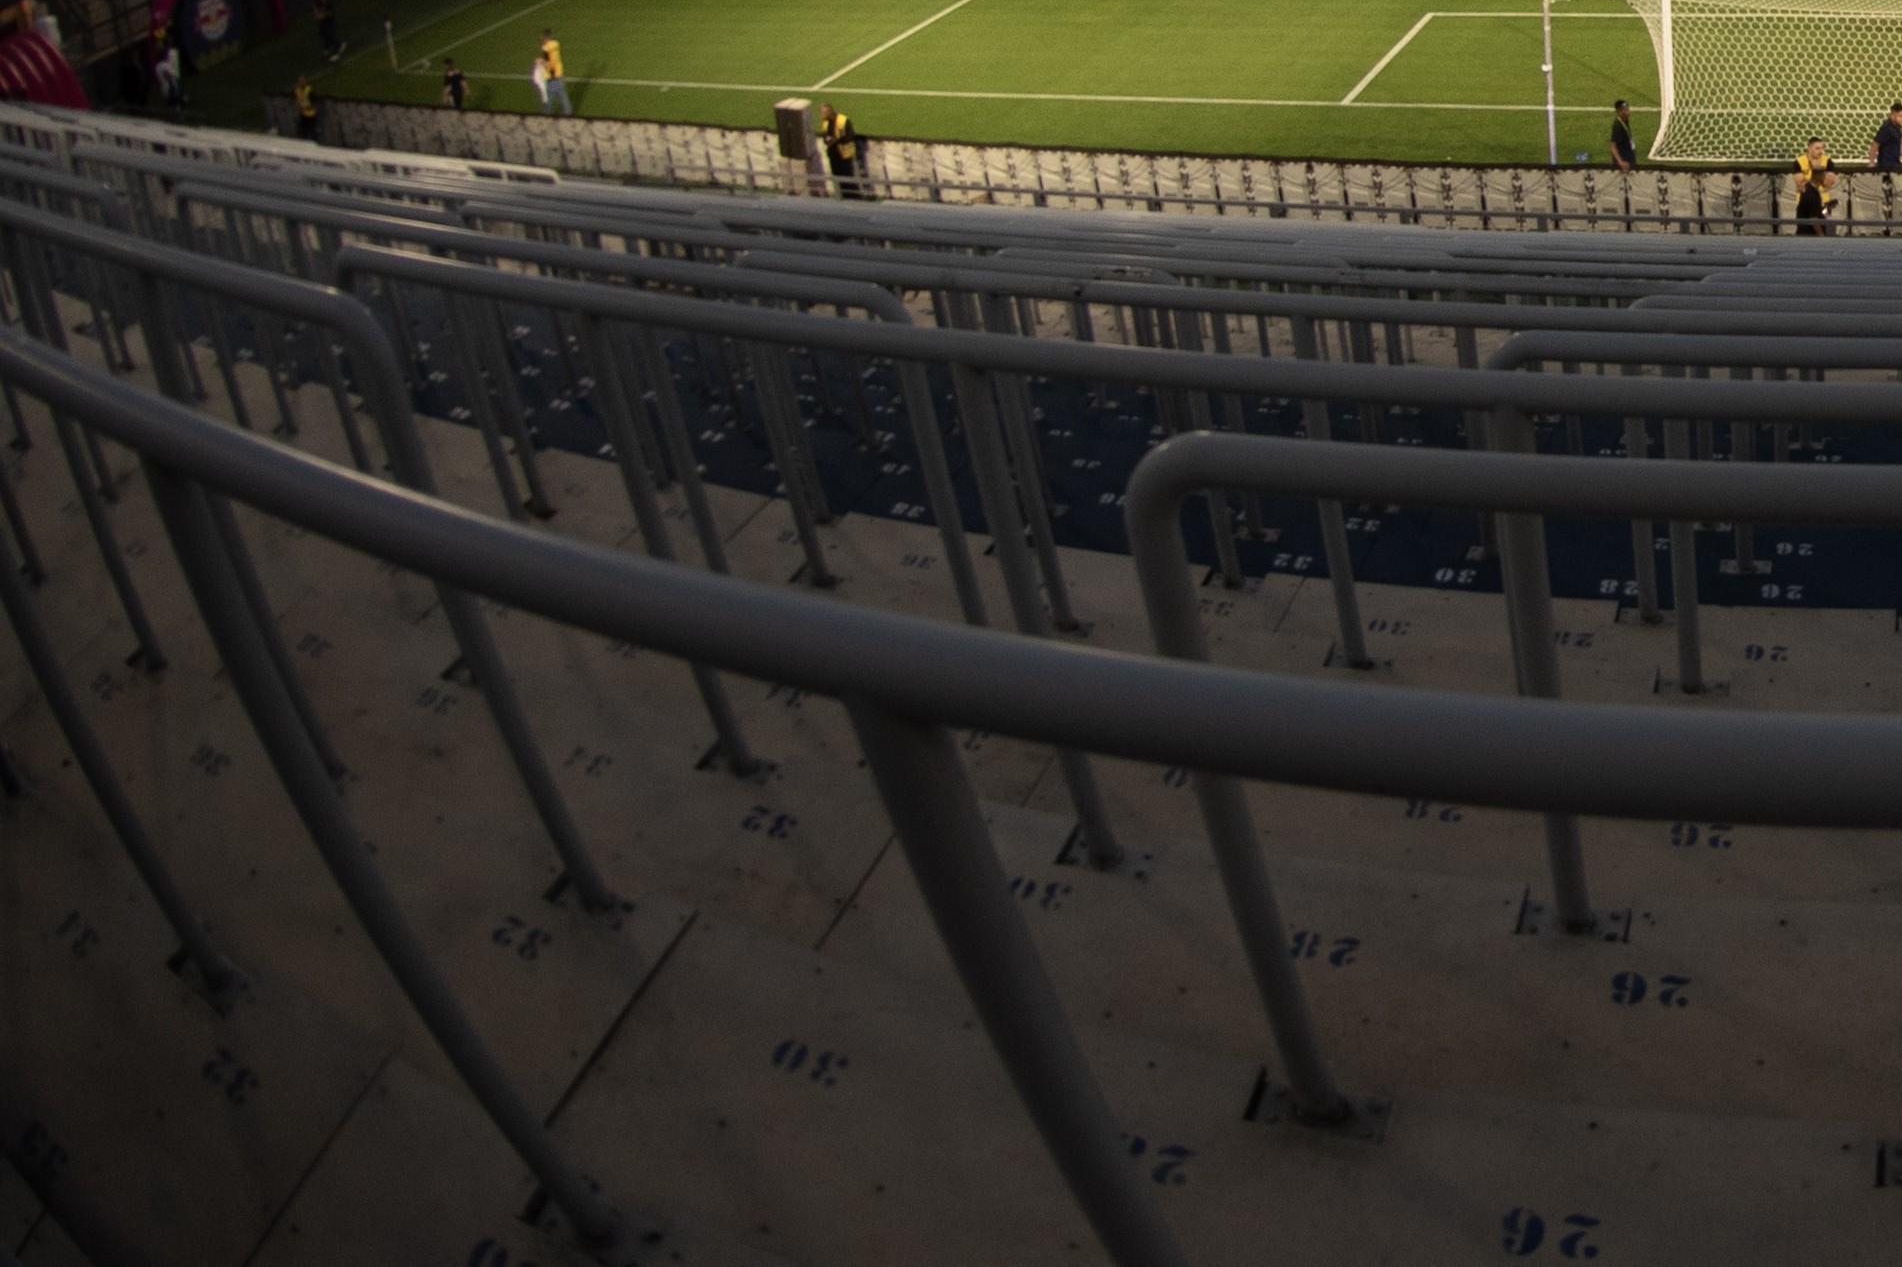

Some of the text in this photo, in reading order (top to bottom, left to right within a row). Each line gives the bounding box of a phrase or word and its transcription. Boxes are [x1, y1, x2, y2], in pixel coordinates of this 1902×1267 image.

[1346, 517, 1380, 532] 32
[1273, 553, 1312, 570] 32
[1776, 542, 1814, 557] 26
[1434, 567, 1476, 584] 30
[1600, 580, 1638, 595] 28
[1761, 584, 1804, 600] 26
[1368, 619, 1411, 635] 30
[1745, 644, 1788, 661] 26
[742, 805, 798, 839] 32
[1670, 823, 1734, 848] 26
[1011, 876, 1072, 910] 30
[492, 916, 552, 960] 32
[1291, 931, 1361, 966] 28
[1611, 971, 1692, 1008] 26
[772, 1039, 849, 1087] 30
[202, 1048, 259, 1106] 32
[1502, 1207, 1600, 1260] 26
